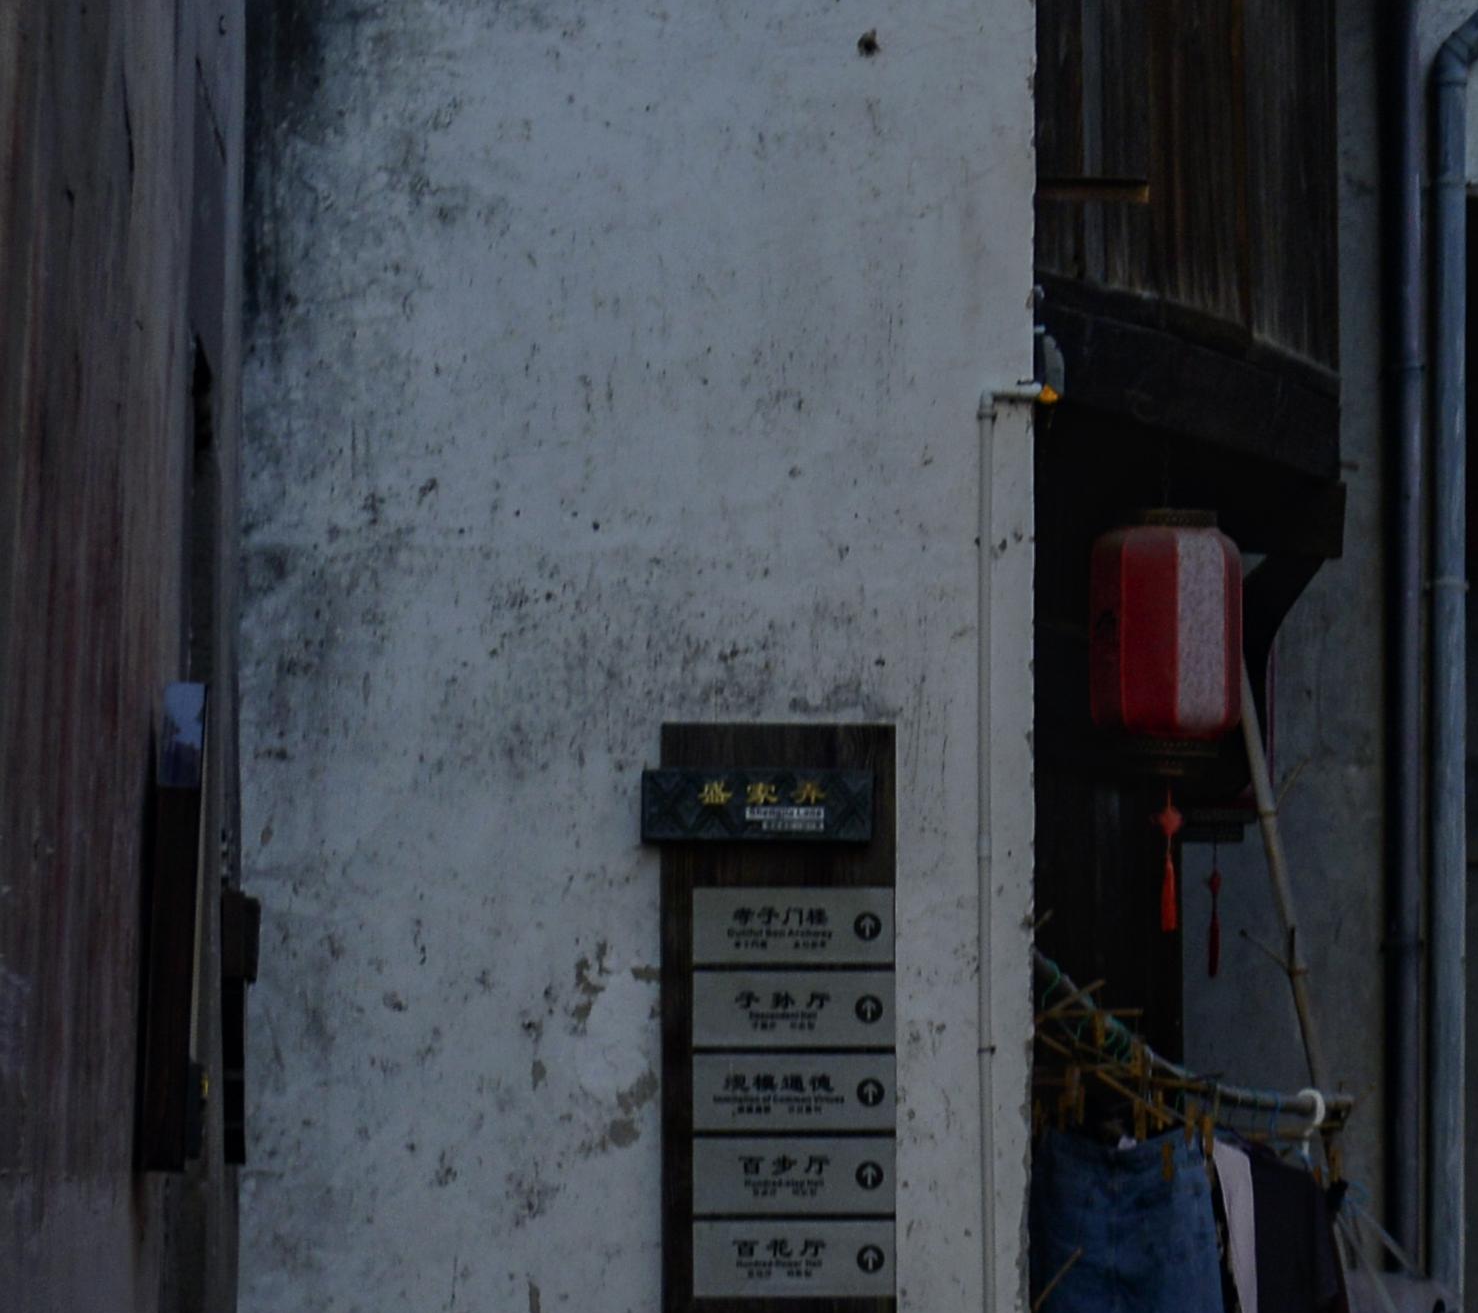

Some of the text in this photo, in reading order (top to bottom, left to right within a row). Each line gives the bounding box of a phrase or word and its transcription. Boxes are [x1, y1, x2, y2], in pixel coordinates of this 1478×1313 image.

[697, 779, 827, 807] 盛家弄
[735, 991, 832, 1010] 子孙厅
[738, 1154, 830, 1175] 百步厅
[732, 1238, 827, 1257] 百花厅
